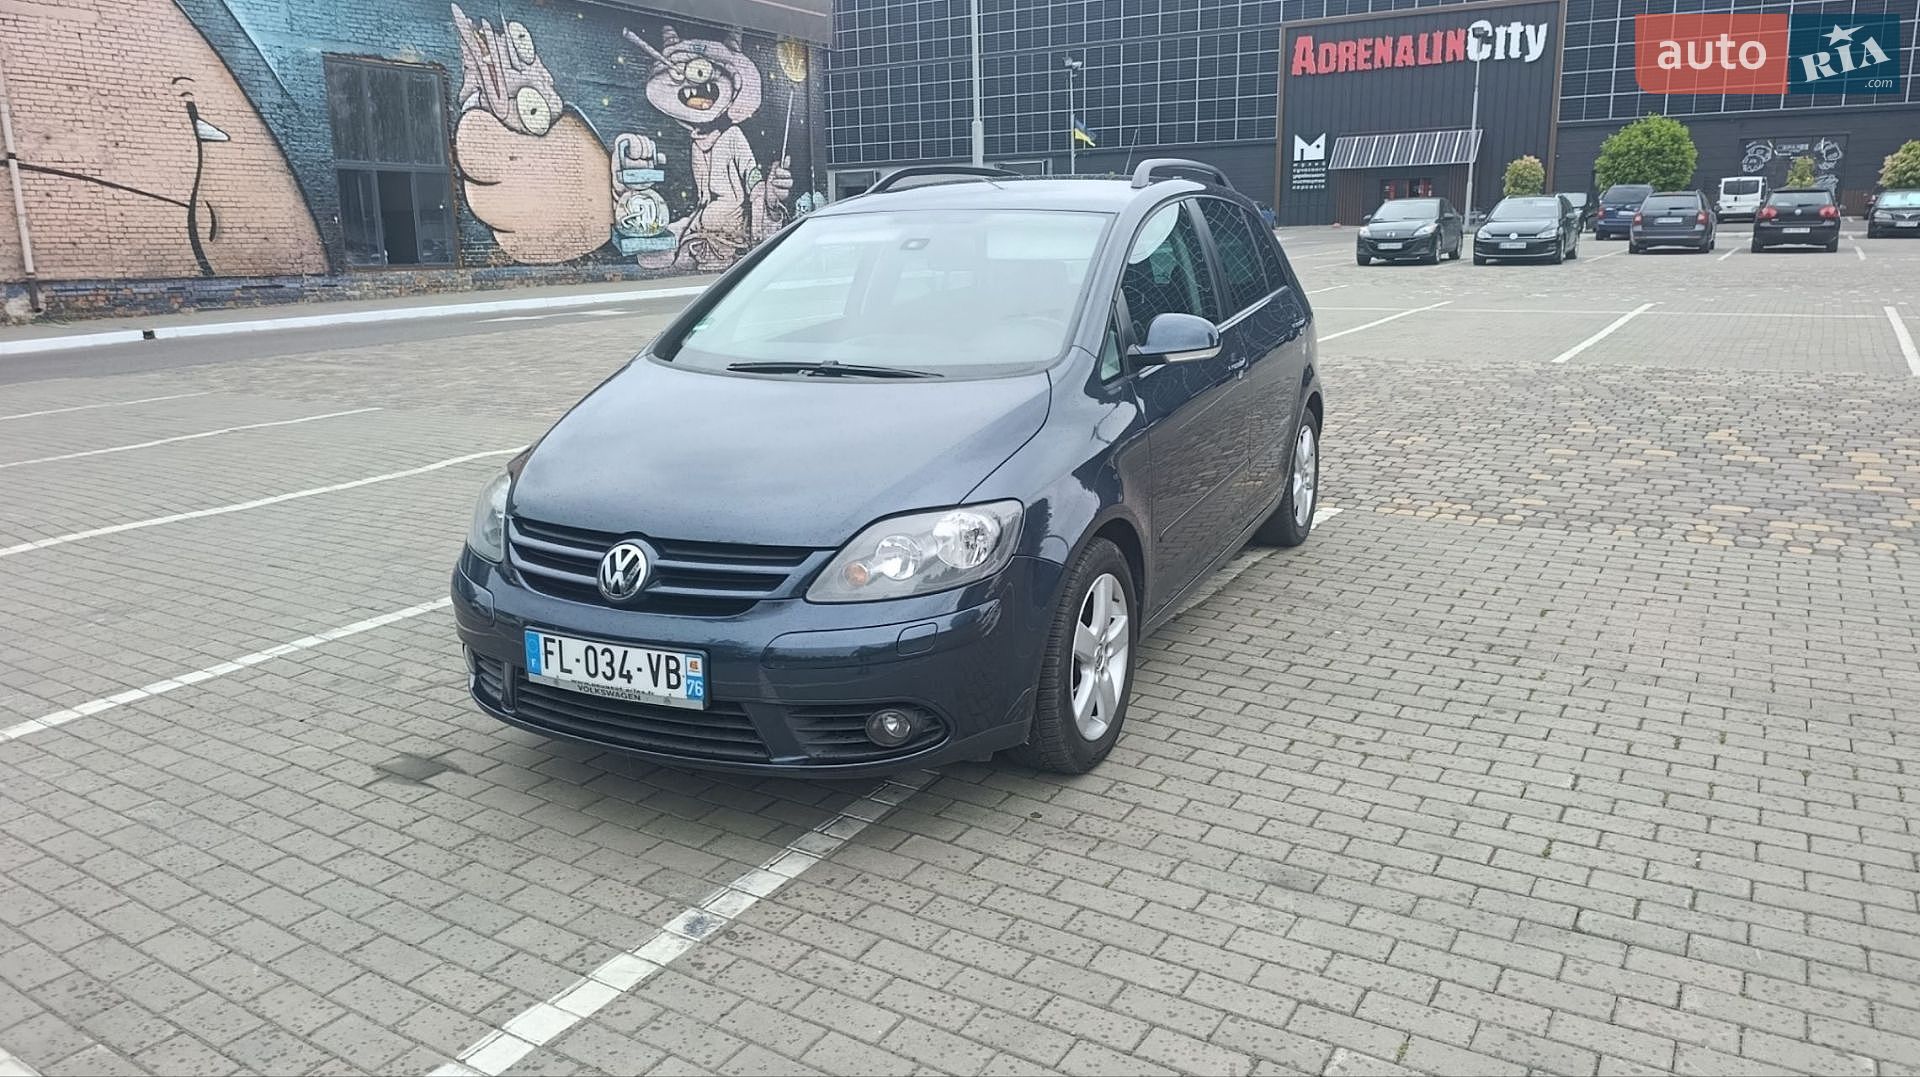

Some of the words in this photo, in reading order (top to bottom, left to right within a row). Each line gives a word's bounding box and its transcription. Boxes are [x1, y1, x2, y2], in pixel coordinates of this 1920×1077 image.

[543, 637, 682, 690] FL-034-VB
[577, 684, 641, 701] VOLKSWAGEN
[686, 679, 704, 696] 76
